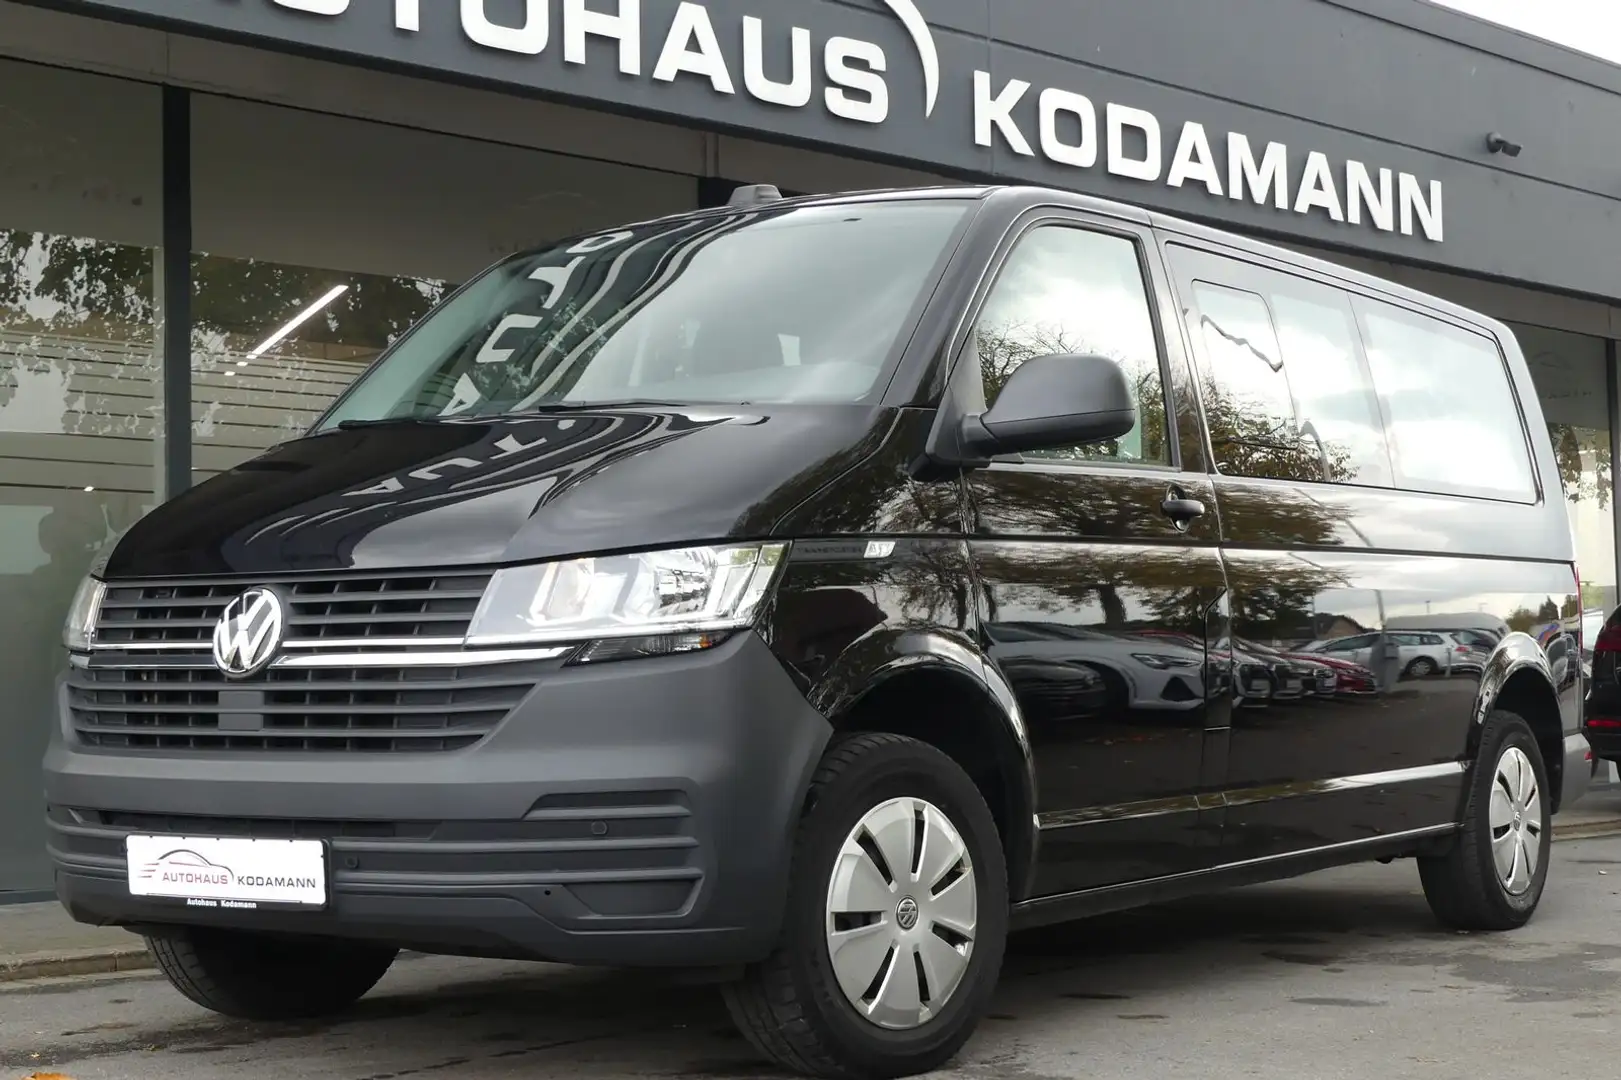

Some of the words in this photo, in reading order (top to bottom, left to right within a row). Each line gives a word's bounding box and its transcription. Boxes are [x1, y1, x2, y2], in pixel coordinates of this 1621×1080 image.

[972, 69, 1444, 243] KODAMANN
[162, 872, 229, 885] AUTOHAUS
[237, 875, 317, 888] KODAMANN
[187, 898, 218, 907] Autohaus
[221, 900, 257, 909] Kodamann
